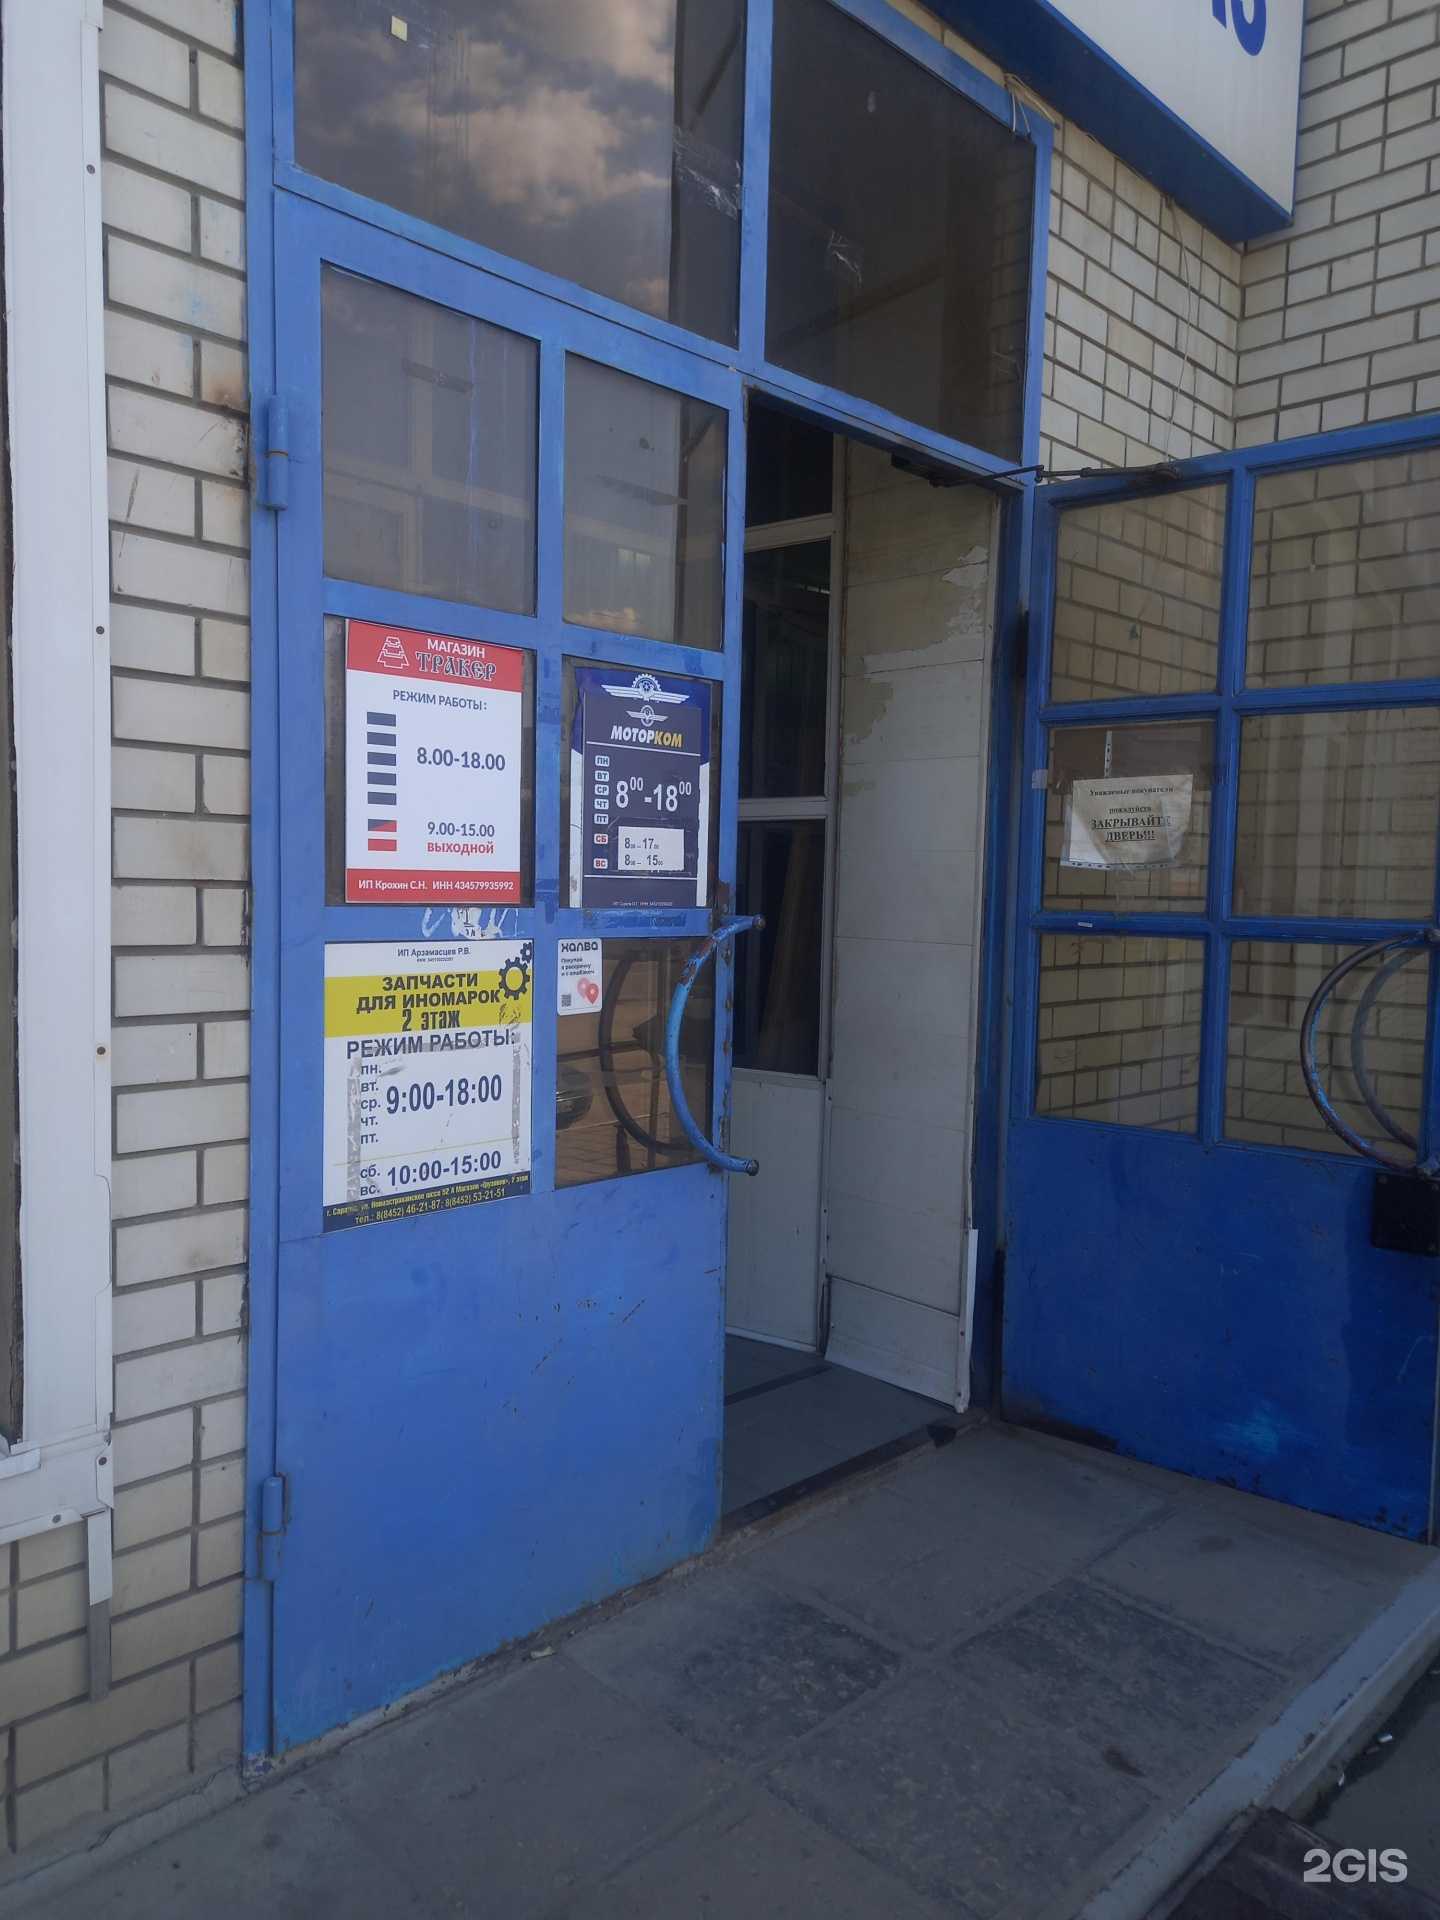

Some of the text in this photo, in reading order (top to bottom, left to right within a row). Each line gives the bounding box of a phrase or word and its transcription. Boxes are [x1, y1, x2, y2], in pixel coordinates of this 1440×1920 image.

[427, 638, 485, 658] МАГАЗИН
[393, 690, 487, 711] РЕЖИМ РАБОТЫ:
[610, 725, 682, 748] МОТОРКОМ
[417, 747, 505, 770] 8.00-18.00
[596, 756, 608, 766] ПН
[597, 770, 608, 780] ВТ
[427, 822, 495, 837] 9.00-15.00
[595, 835, 607, 843] СБ
[595, 860, 606, 868] ВС
[358, 880, 373, 889] ИП
[375, 880, 409, 891] Крохин
[410, 880, 427, 890] С.Н.
[433, 881, 453, 890] ИНН
[383, 973, 478, 991] ЗАПЧАСТИ
[356, 989, 500, 1014] ДЛЯ ИНОМАРОК
[402, 1009, 461, 1032] 2 этаж
[347, 1029, 515, 1059] РЕЖИМ РАБОТЫ:
[361, 1074, 501, 1114] ср. 9:00-18:00
[360, 1150, 501, 1186] сб. 10:00-15:00
